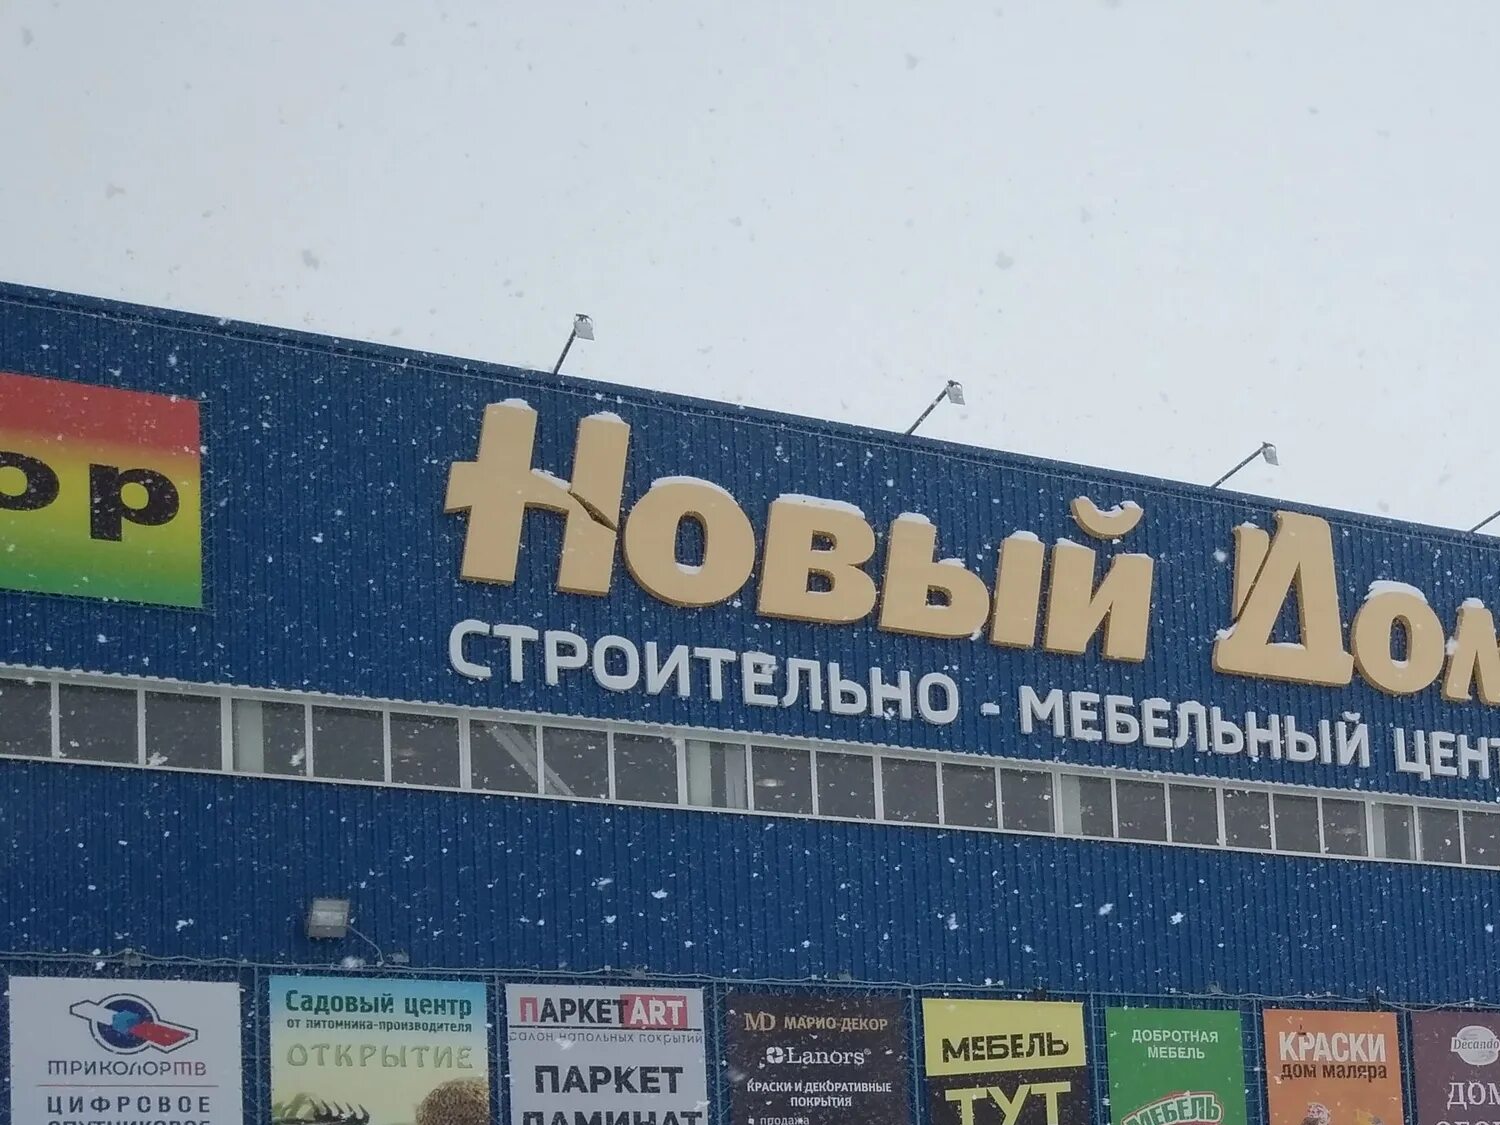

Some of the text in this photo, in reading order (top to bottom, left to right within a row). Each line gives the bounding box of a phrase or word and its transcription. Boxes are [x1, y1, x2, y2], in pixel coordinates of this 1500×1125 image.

[449, 620, 960, 725] СТРОИТЕЛЬНО
[1019, 685, 1370, 768] МЕБЕЛЬНЫЙ
[285, 989, 472, 1019] Садовый центр
[287, 1018, 472, 1033] от питомника-производителя
[784, 1016, 888, 1032] МАРИО-ДЕКОР
[509, 1031, 704, 1045] салон напольных покрытий
[1132, 1029, 1218, 1043] ДОБРОТНАЯ
[287, 1043, 473, 1069] ОТКРЫТИЕ
[942, 1032, 1069, 1063] МЕБЕЛЬ
[1147, 1046, 1205, 1059] МЕБЕЛЬ
[1279, 1031, 1386, 1062] КРАСКИ
[535, 1065, 683, 1094] ПАРКЕТ
[1281, 1064, 1387, 1083] дом маляра
[747, 1081, 892, 1094] КРАСКИ И ДЕКОРАТИВНЫЕ
[48, 1096, 210, 1115] ЦИФРОВОЕ
[790, 1096, 852, 1108] ПОКРЫТИЯ
